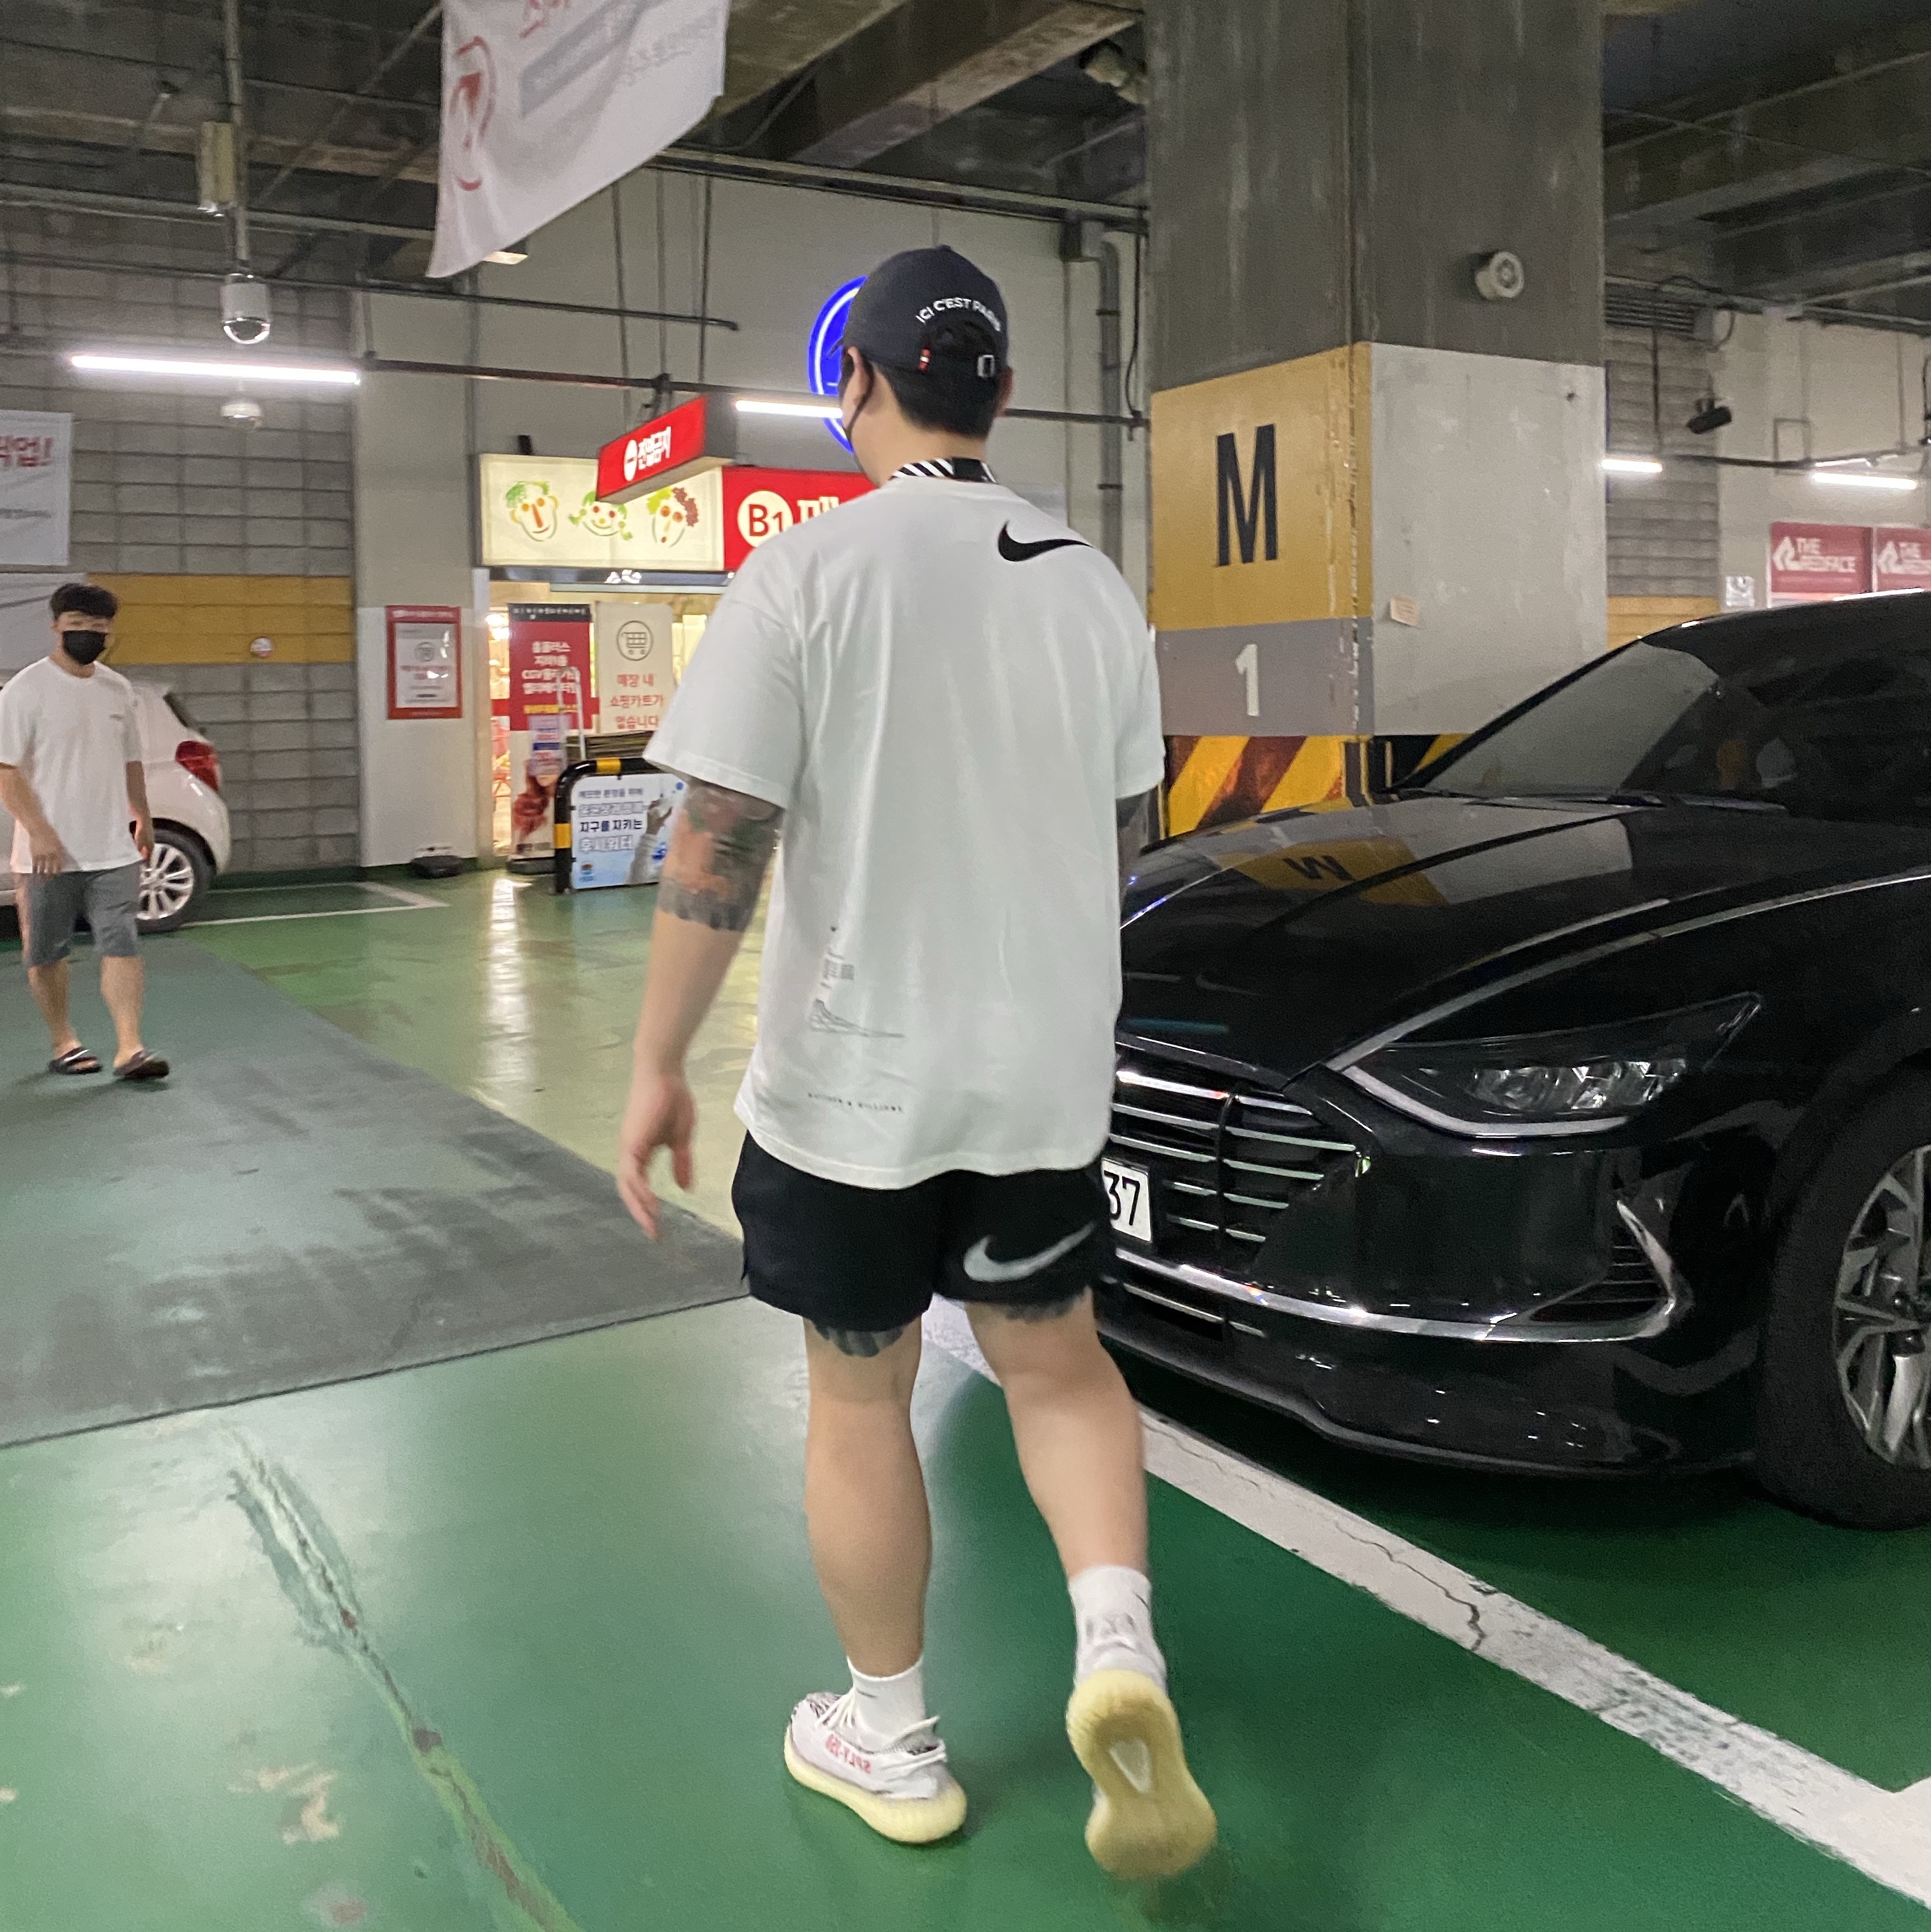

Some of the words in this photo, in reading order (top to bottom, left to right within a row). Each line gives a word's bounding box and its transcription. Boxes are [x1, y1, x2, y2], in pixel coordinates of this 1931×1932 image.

[916, 307, 934, 323] ICI
[1216, 423, 1277, 567] M
[749, 503, 784, 537] B1
[617, 674, 639, 687] 매장
[643, 673, 654, 687] 내
[1235, 643, 1259, 717] 1
[610, 694, 664, 708] 쇼핑카트가
[616, 715, 659, 729] 없습니다
[580, 820, 609, 832] 지구를
[612, 819, 643, 831] 지키는
[1104, 1170, 1140, 1226] 37
